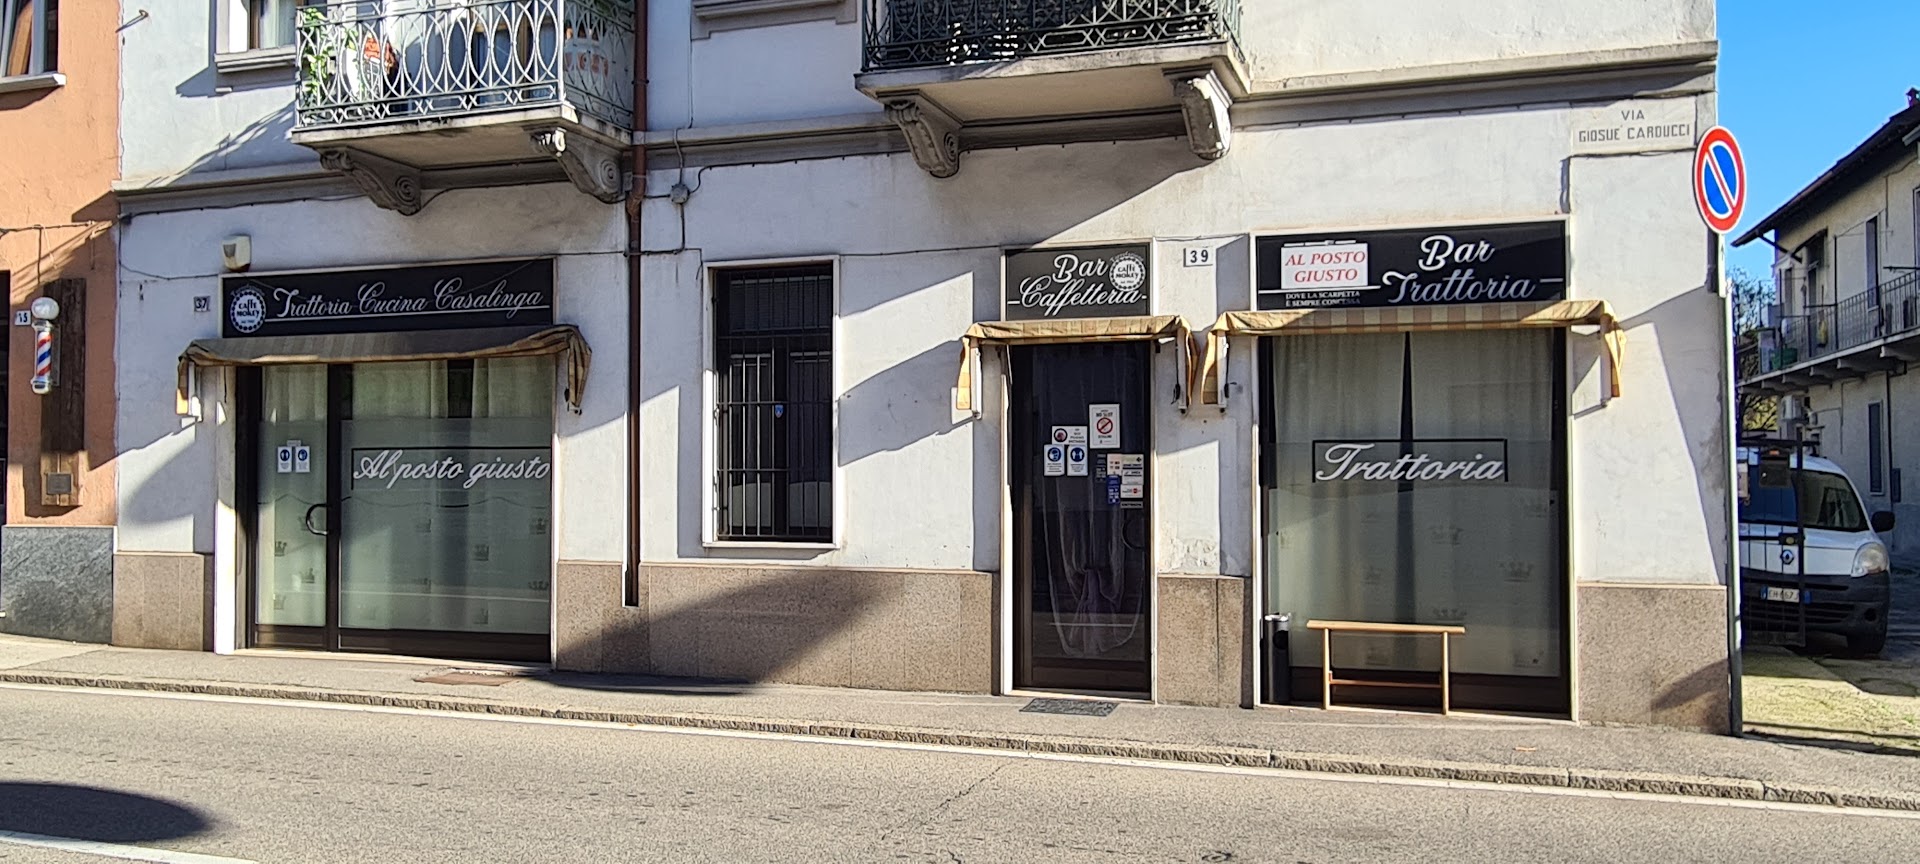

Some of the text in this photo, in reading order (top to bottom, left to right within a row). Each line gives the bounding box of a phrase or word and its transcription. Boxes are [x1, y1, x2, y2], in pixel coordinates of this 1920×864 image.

[1621, 110, 1645, 121] VIA
[1627, 124, 1690, 140] CARDUCCI
[1190, 249, 1209, 263] 39
[1285, 251, 1366, 267] AL POSTO
[1418, 234, 1495, 271] Bar
[1052, 254, 1109, 283] Bar
[1294, 268, 1358, 283] GIUSTO
[1382, 268, 1536, 303] Trattoria
[194, 297, 208, 309] 37
[273, 277, 543, 319] Trattoria Cucina Casalinga
[1020, 275, 1142, 316] Caffetteria
[1285, 292, 1306, 300] DOVE
[1319, 290, 1361, 298] SCARPETTA
[18, 312, 28, 323] 15
[353, 449, 551, 490] Al posto giusto
[1315, 443, 1504, 481] Trattoria
